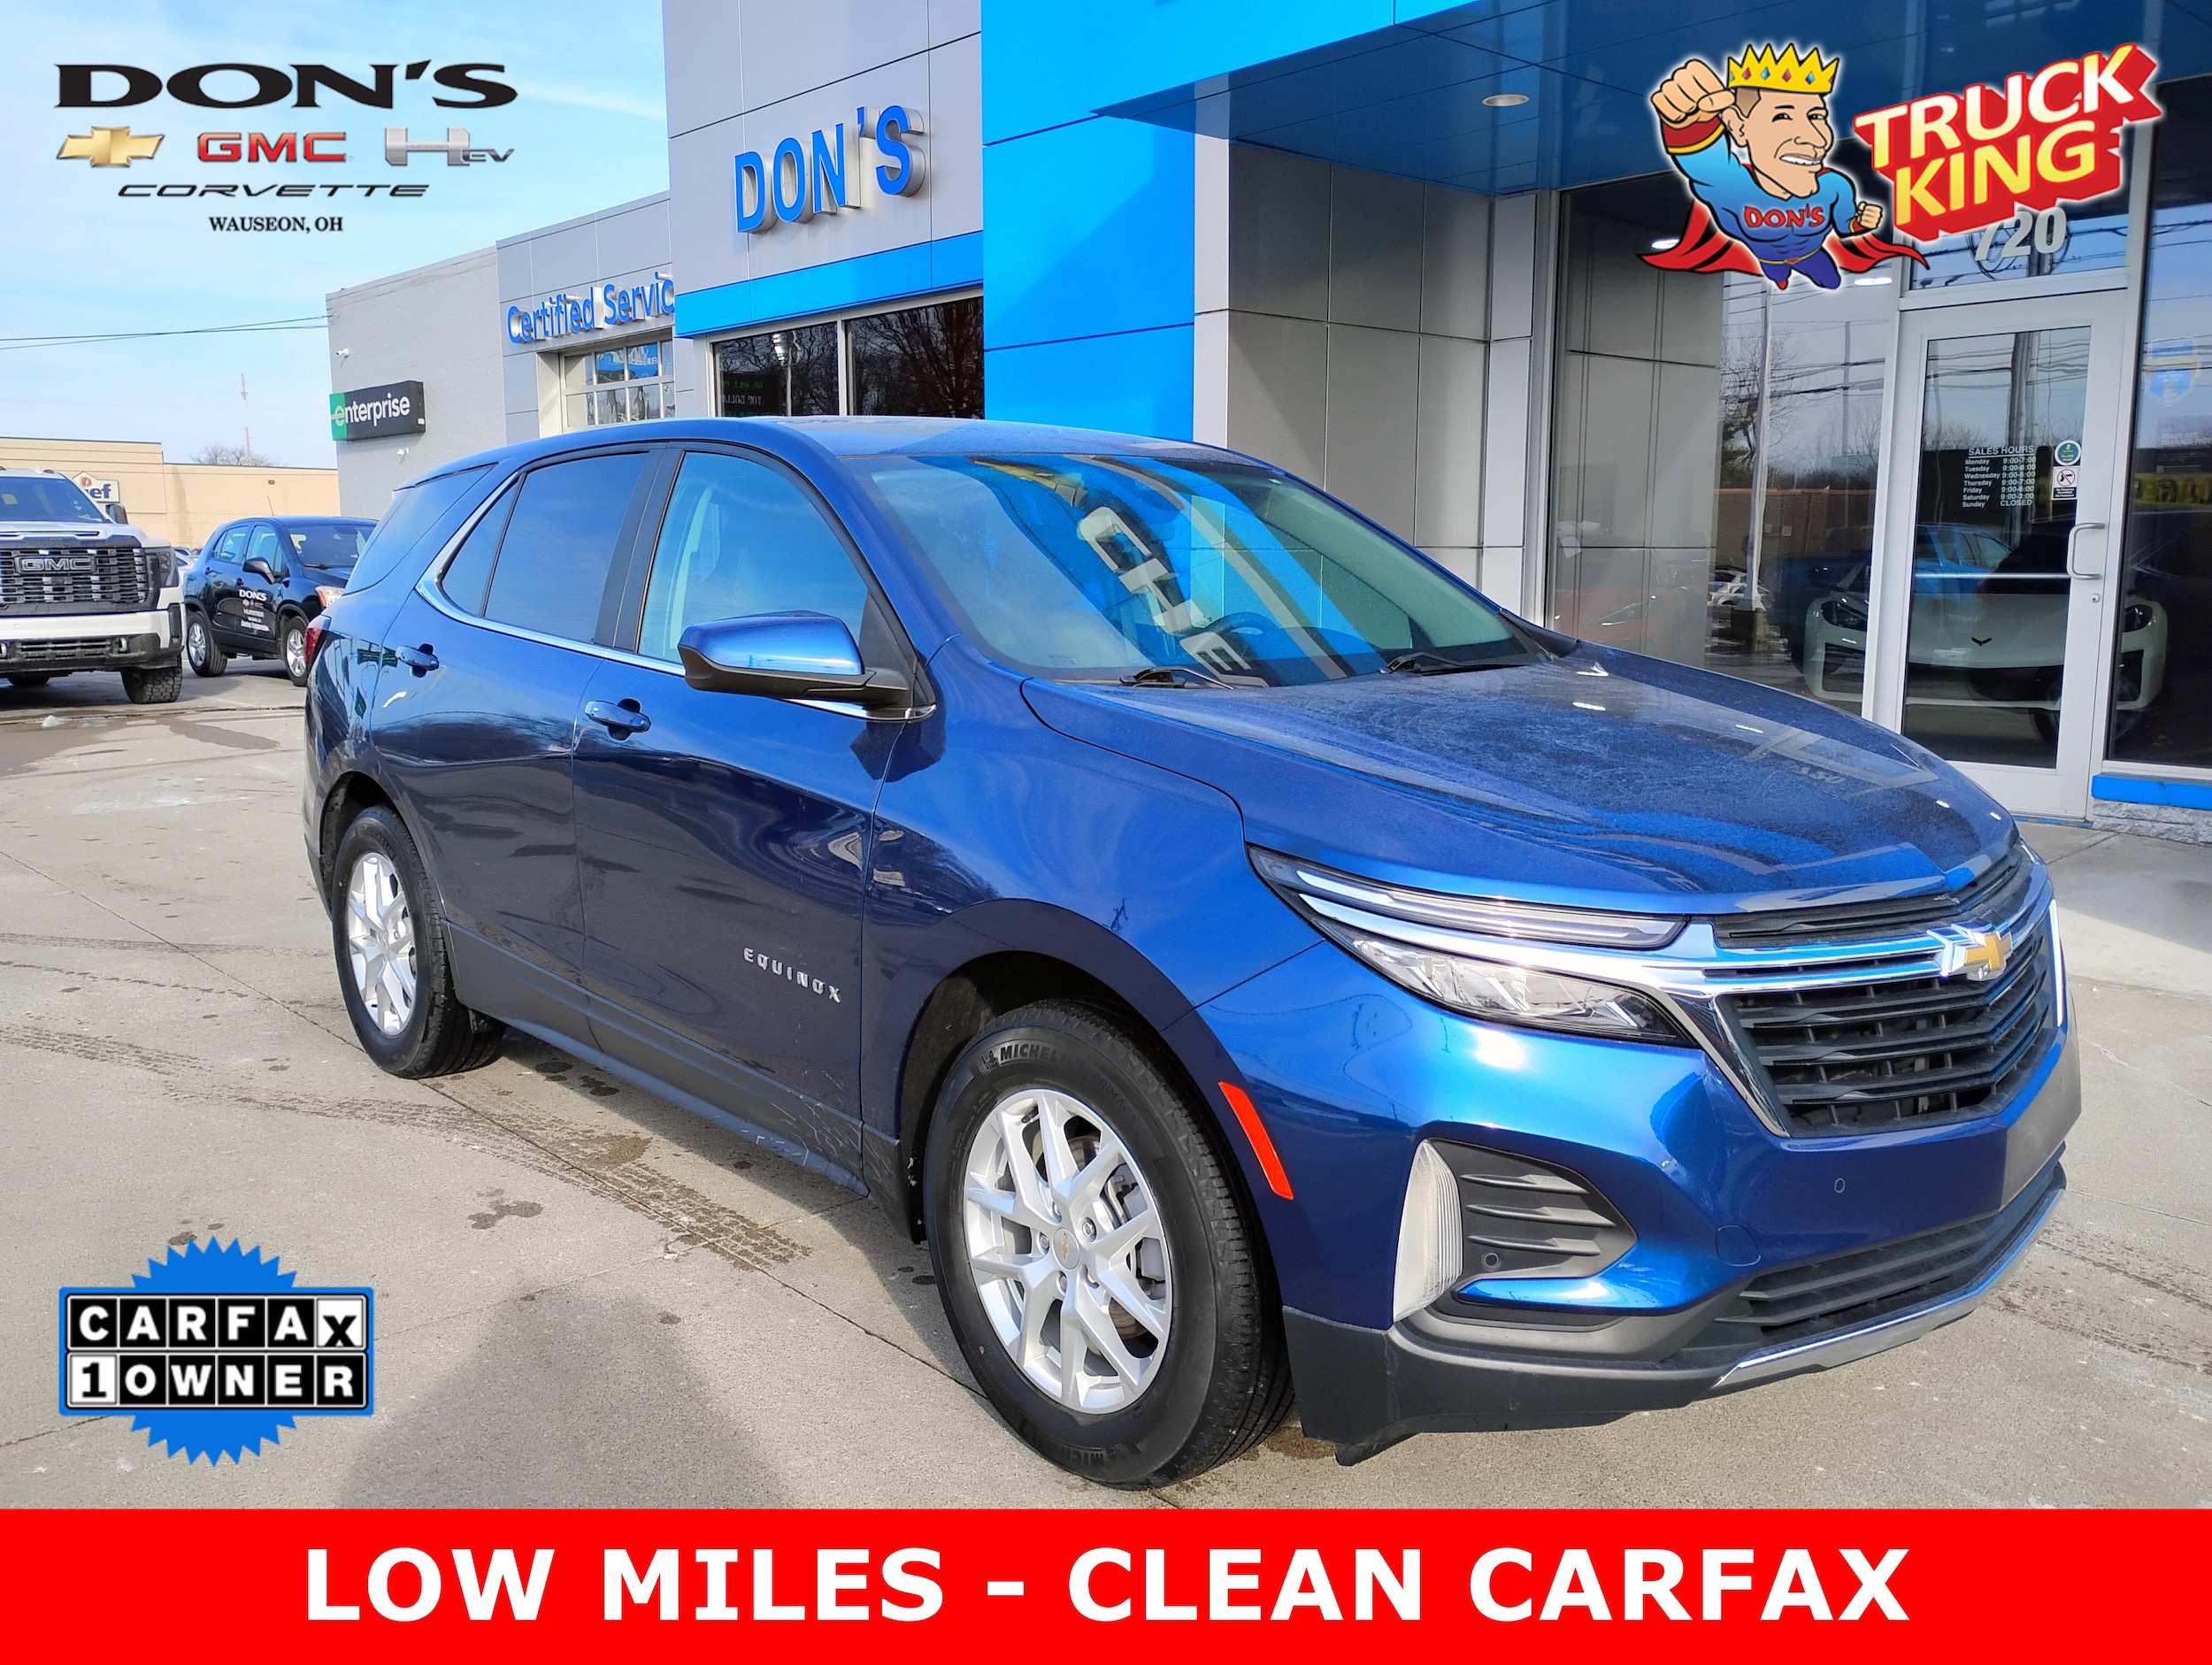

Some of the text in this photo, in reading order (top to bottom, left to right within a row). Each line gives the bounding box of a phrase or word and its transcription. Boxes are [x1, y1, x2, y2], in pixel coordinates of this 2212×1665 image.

[734, 105, 911, 232] DON'S
[507, 272, 674, 343] Certified Servic
[331, 392, 411, 426] enterprise
[1968, 445, 2035, 456] SALES HOURS
[86, 483, 111, 499] ef
[22, 558, 91, 571] GMC
[744, 948, 841, 1003] EQUINOX
[1000, 1044, 1067, 1063] MICHEL
